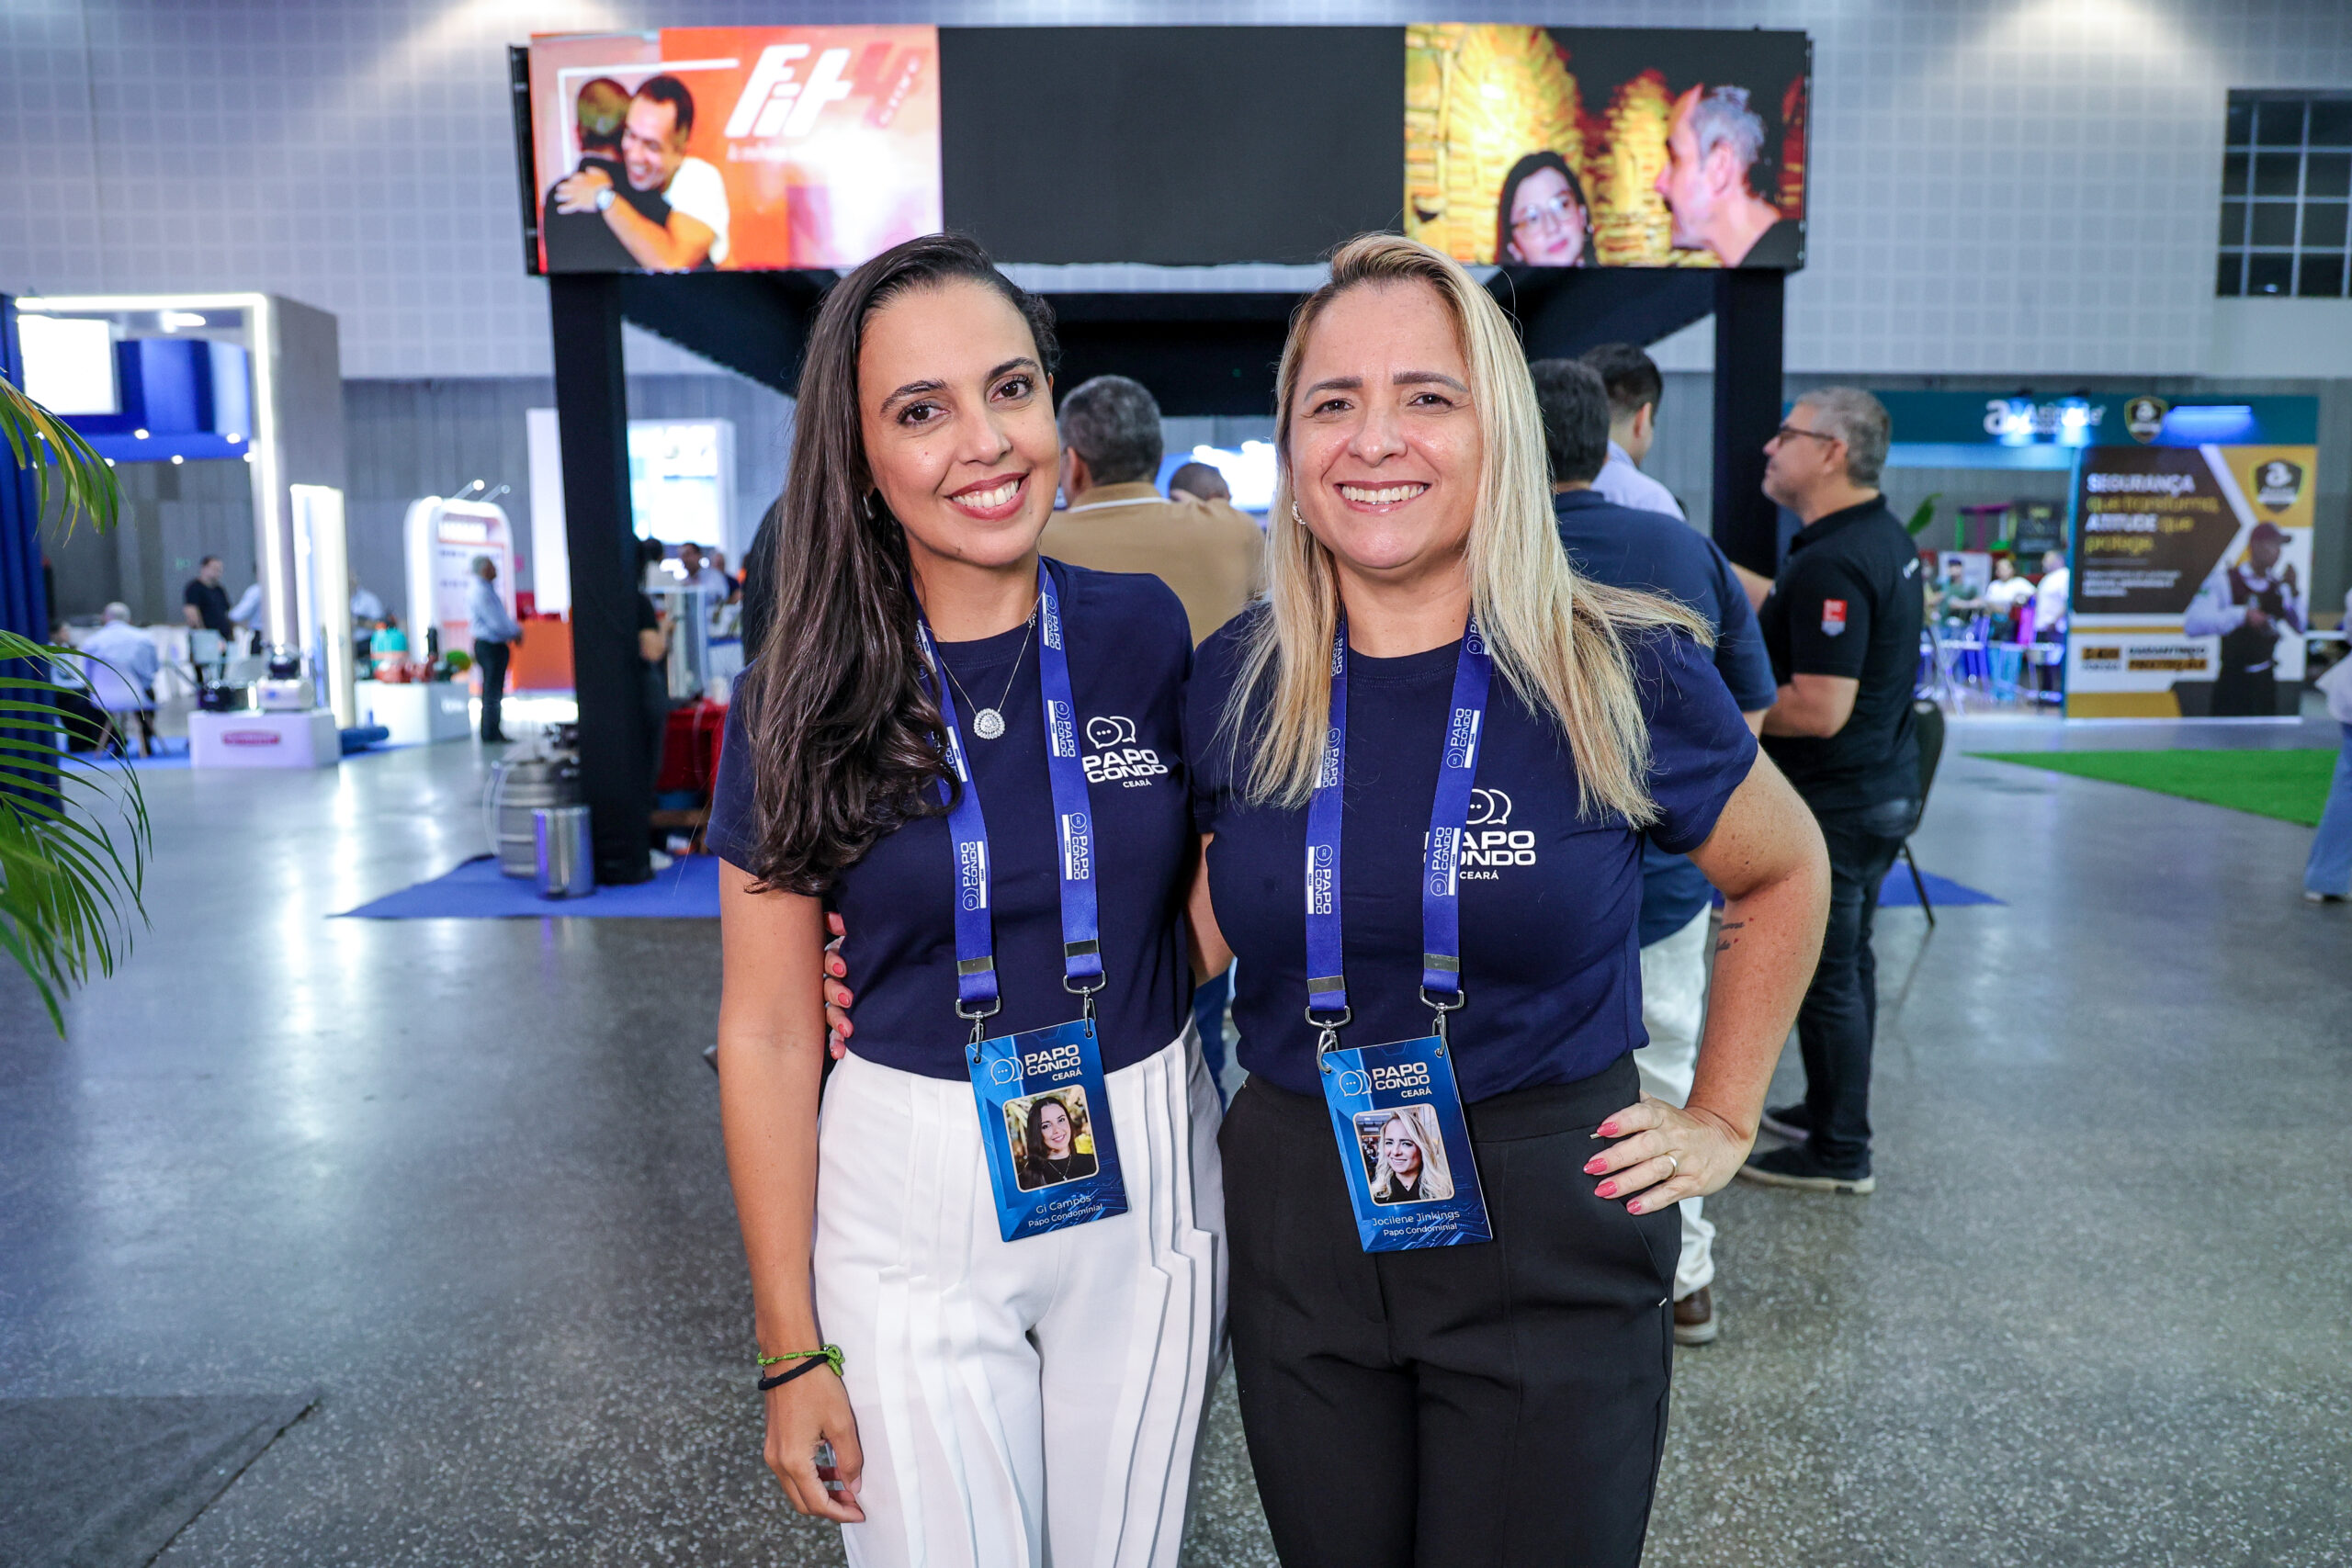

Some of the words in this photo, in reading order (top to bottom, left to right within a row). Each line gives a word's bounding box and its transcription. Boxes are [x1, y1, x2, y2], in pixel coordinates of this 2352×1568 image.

[1047, 614, 1056, 649] CONDO
[1051, 615, 1061, 650] PAPO
[1057, 720, 1068, 758] CONDO
[1063, 721, 1076, 758] PAPO
[1451, 708, 1464, 747] PAPO
[1460, 709, 1472, 747] CONDO
[1081, 749, 1159, 773] PAPO
[1086, 763, 1169, 784] CONDO
[1323, 750, 1331, 788] CONDO
[1329, 748, 1340, 787] PAPO
[1123, 778, 1152, 788] CEARÁ
[1424, 830, 1535, 850] APO
[1431, 827, 1445, 871] PAPO
[1441, 827, 1453, 871] CONDO
[960, 841, 971, 887] PAPO
[968, 840, 978, 886] CONDO
[1071, 836, 1080, 880] CONDO
[1079, 835, 1090, 880] PAPO
[1423, 850, 1536, 866] NDO
[1459, 870, 1499, 880] CEARÁ
[1315, 869, 1323, 915] CONDO
[1322, 868, 1332, 915] PAPO
[1024, 1043, 1080, 1066] PAPO
[1027, 1055, 1081, 1077] CONDO
[1052, 1066, 1082, 1081] CEARÁ
[1372, 1062, 1428, 1080] PAPO
[1374, 1074, 1430, 1090] CONDO
[1400, 1086, 1432, 1098] CEARÁ
[1028, 1218, 1049, 1228] Papo
[1051, 1203, 1103, 1222] Condominial
[1035, 1204, 1047, 1214] Gi
[1049, 1195, 1091, 1211] Campos
[1372, 1215, 1414, 1226] Jocilene
[1416, 1211, 1461, 1222] Jinkings
[1383, 1229, 1405, 1237] Papo
[1406, 1223, 1458, 1235] Condominial
